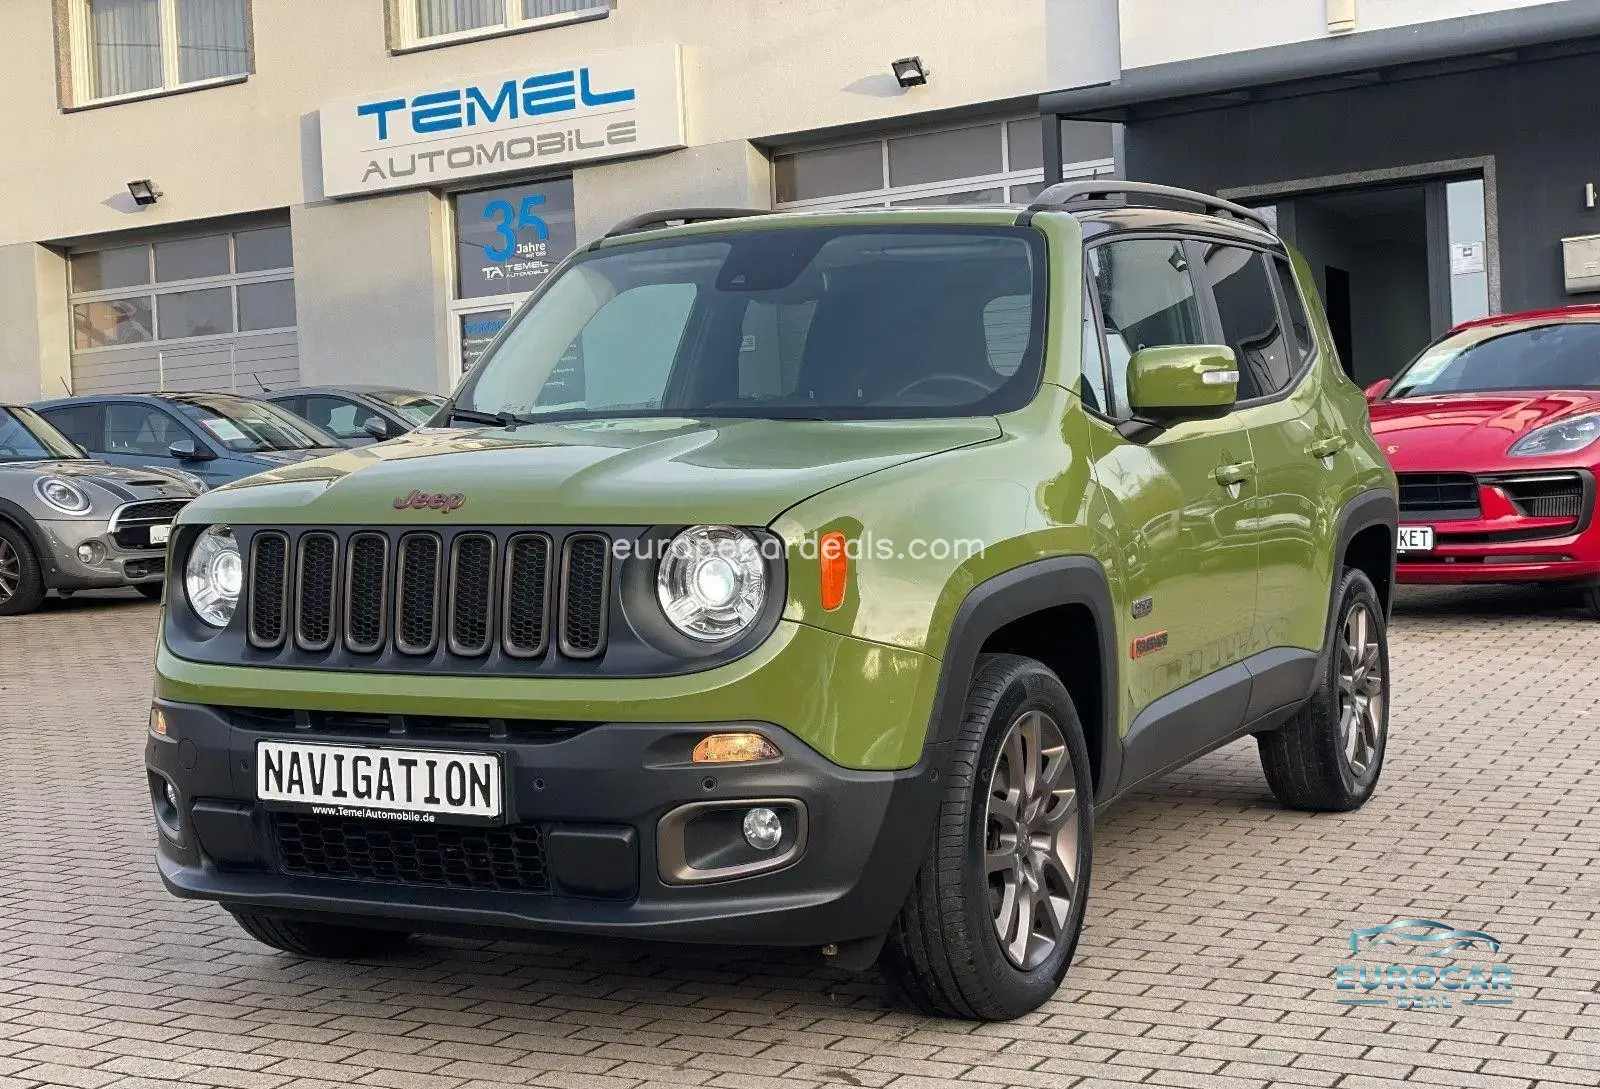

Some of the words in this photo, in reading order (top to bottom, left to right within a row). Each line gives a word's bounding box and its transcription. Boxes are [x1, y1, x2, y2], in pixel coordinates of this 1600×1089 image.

[357, 67, 636, 141] TEMEL
[484, 194, 549, 262] 35
[516, 242, 546, 254] Jahre
[504, 260, 549, 272] TEMEL
[393, 488, 466, 514] Jeep
[263, 748, 491, 808] NAVIGATION
[312, 804, 435, 823] www.TemelAutomobile.de
